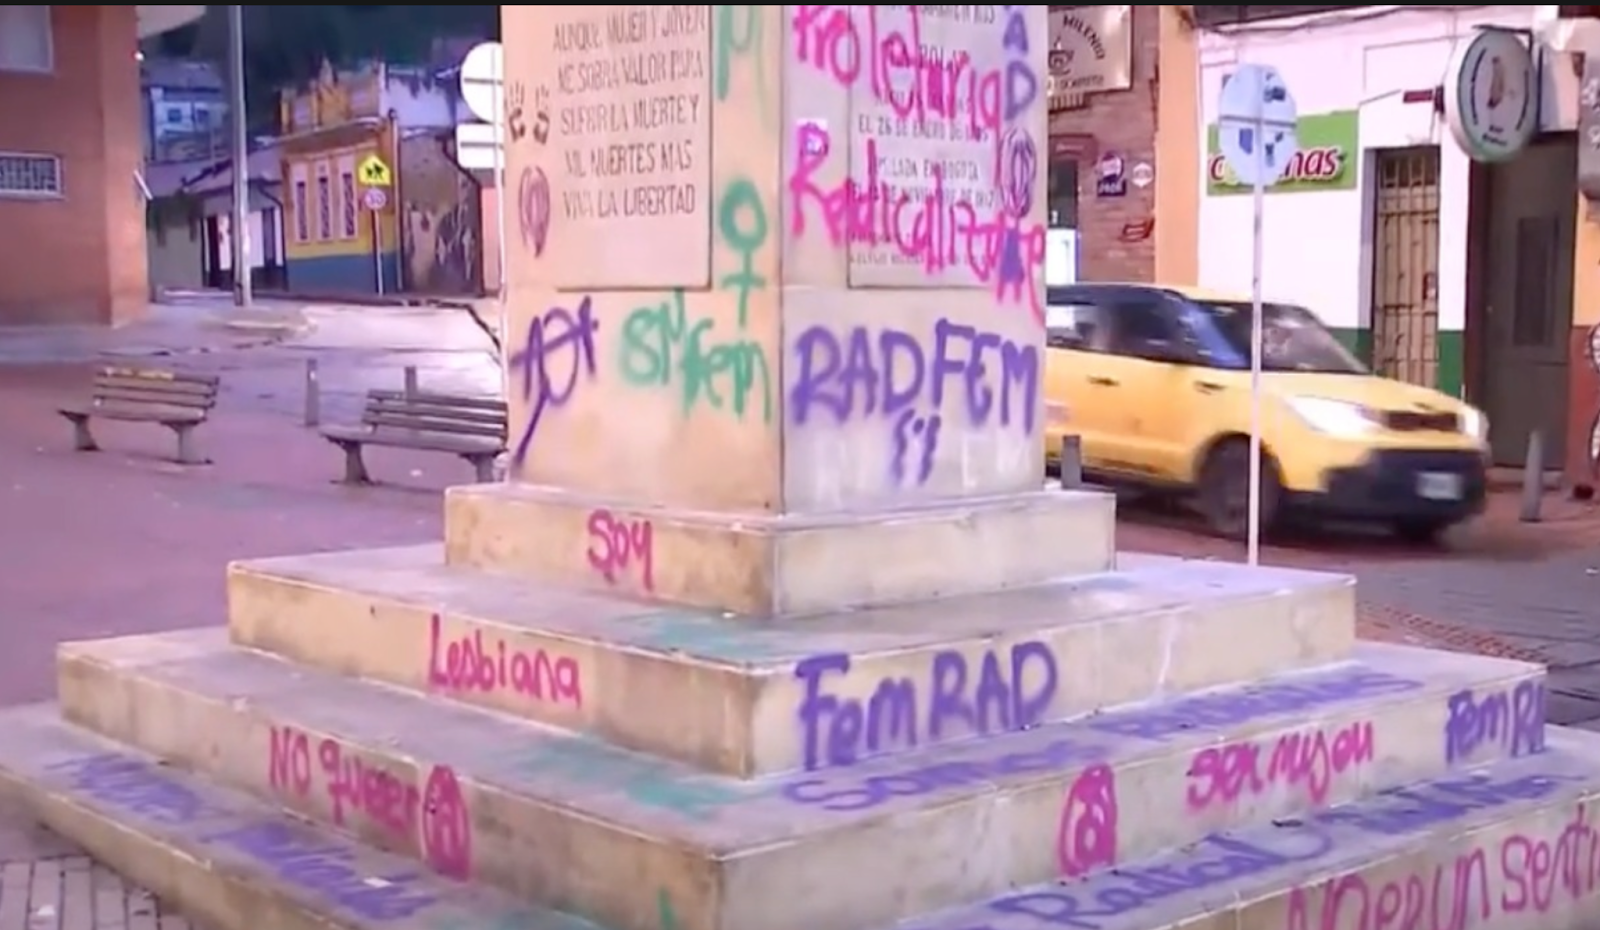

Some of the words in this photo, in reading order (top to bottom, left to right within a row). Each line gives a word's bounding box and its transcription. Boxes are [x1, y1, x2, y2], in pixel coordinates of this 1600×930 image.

[621, 52, 666, 85] VALOR
[610, 102, 628, 132] LA
[633, 95, 686, 129] MUERTE
[689, 94, 699, 124] Y
[661, 139, 692, 172] MAS
[598, 188, 618, 218] LA
[623, 183, 696, 217] LIBERTAD
[428, 613, 583, 709] Lesbiana
[269, 726, 310, 796] NO
